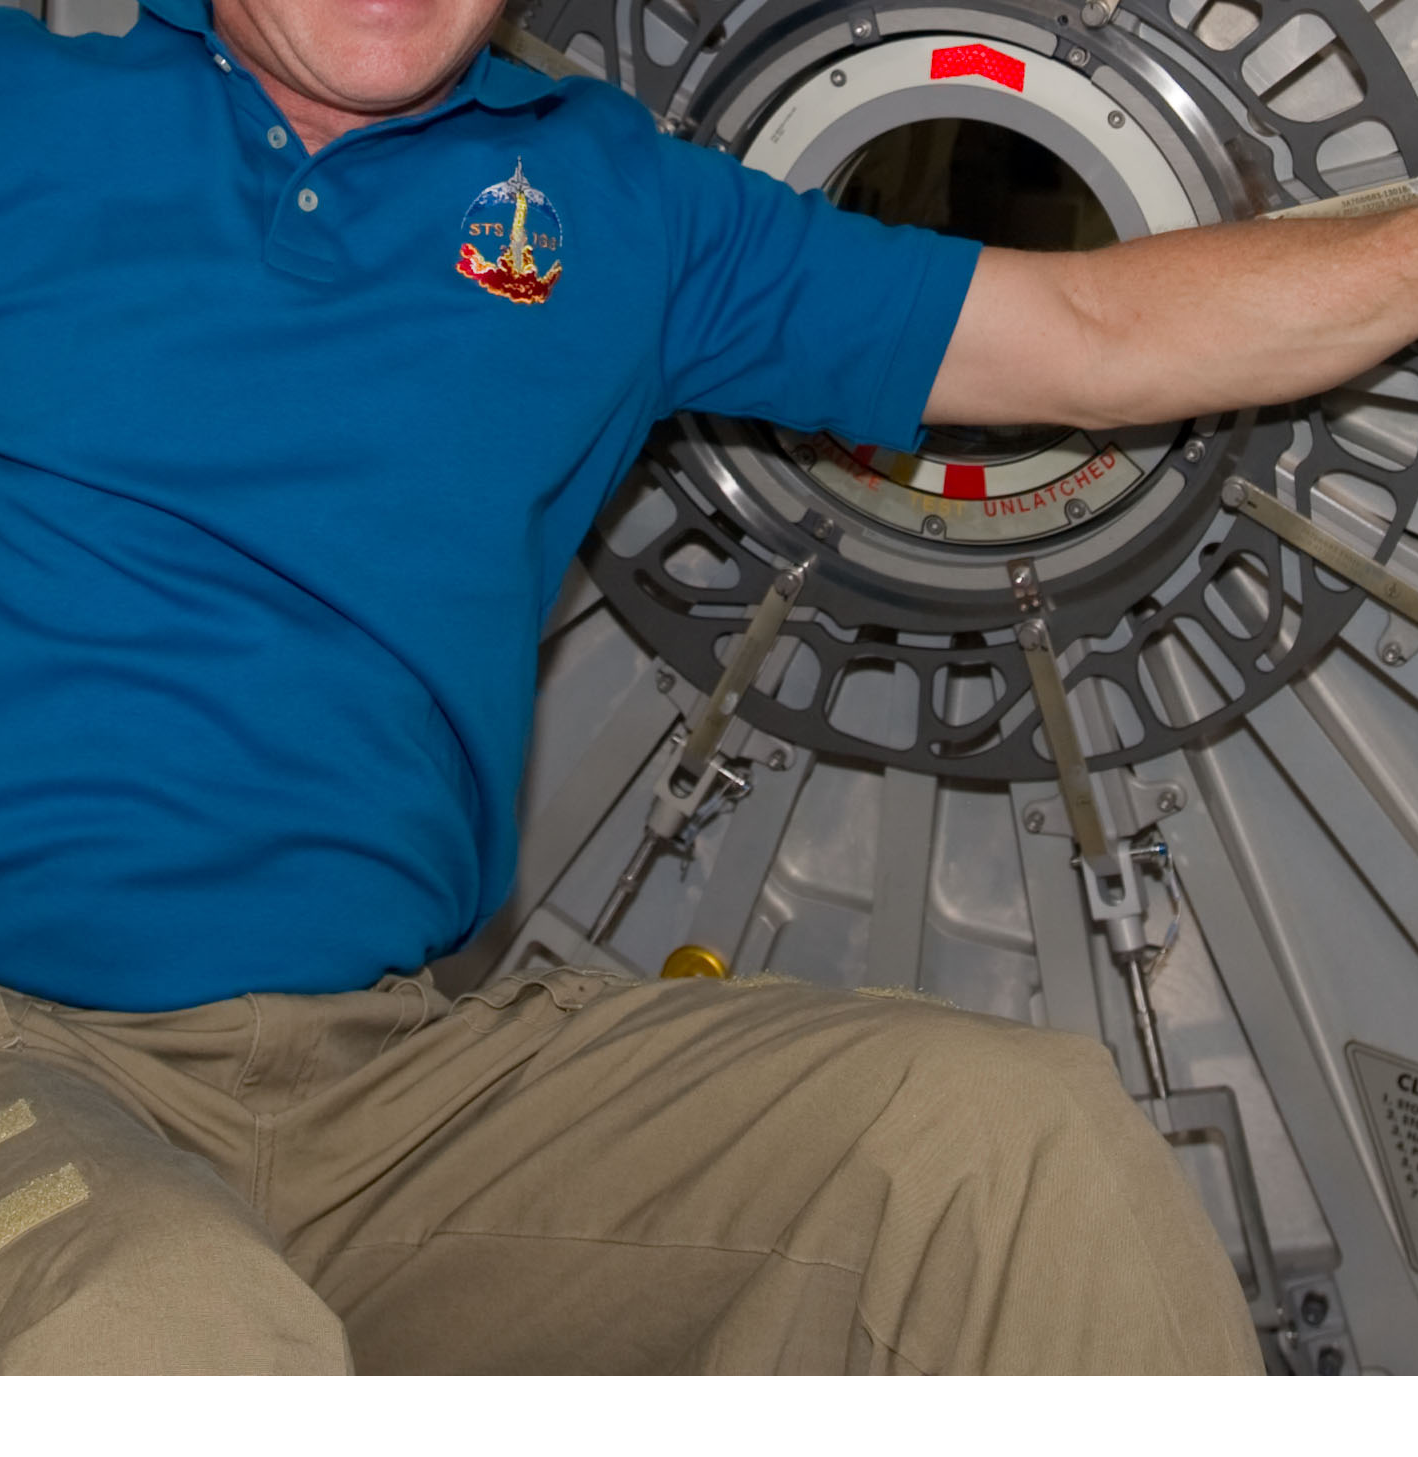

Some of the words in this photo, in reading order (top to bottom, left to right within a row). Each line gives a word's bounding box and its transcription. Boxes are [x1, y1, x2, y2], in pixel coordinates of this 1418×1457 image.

[469, 223, 504, 237] STS
[912, 492, 967, 517] TEST
[984, 448, 1118, 518] UNLATCHED
